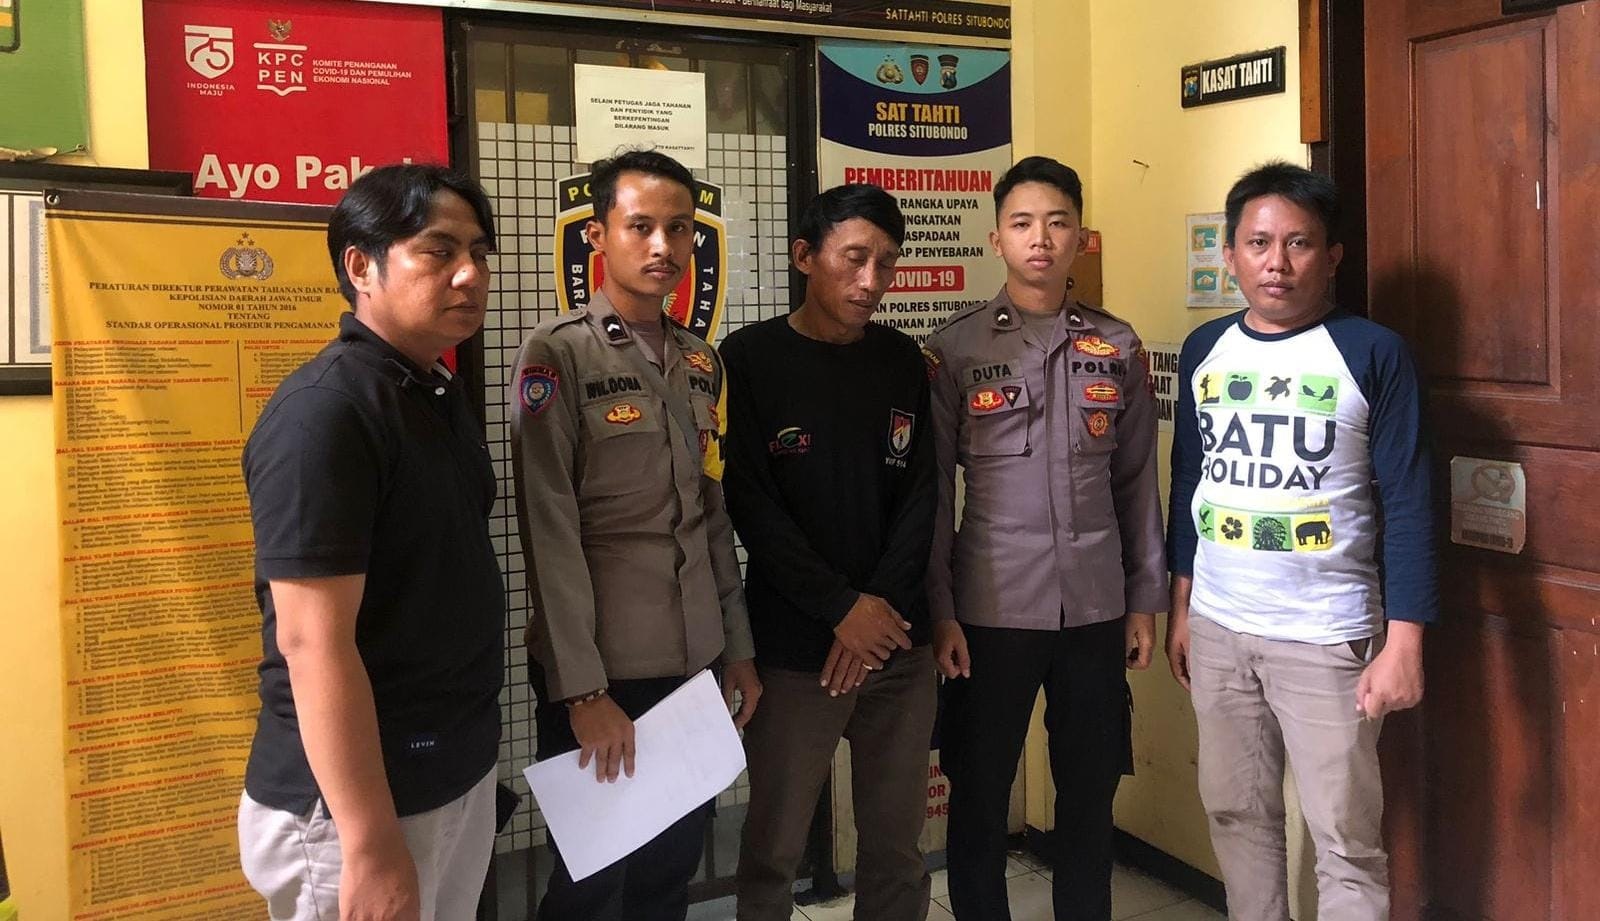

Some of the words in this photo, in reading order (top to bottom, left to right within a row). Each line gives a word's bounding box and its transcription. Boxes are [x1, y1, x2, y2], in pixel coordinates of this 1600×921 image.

[885, 8, 929, 23] SATTAHTI
[931, 11, 962, 25] POLRES
[966, 15, 1010, 29] SITUBONDO
[258, 52, 304, 67] KPC
[312, 59, 343, 68] KOMITE
[344, 61, 397, 70] PENANGANAN
[259, 69, 304, 84] PEN
[312, 68, 348, 76] COVID-19
[350, 68, 366, 77] DAN
[367, 70, 412, 78] PEMULIHAN
[1202, 64, 1238, 94] KASAT
[1238, 57, 1273, 88] TAHTI
[187, 82, 235, 90] INDONESIA
[313, 76, 350, 84] EKONOMI
[614, 115, 670, 123] BERKEPENTINGAN
[876, 102, 908, 122] SAT
[911, 103, 960, 124] TAHTI
[868, 123, 907, 138] POLRES
[909, 124, 968, 140] SITUBONDO
[195, 153, 280, 199] Ayo
[295, 155, 375, 190] Pak
[845, 167, 992, 192] PEMBERITAHUAN
[900, 198, 944, 209] RANGKA
[946, 199, 979, 210] UPAYA
[904, 214, 961, 226] INGKATKAN
[904, 231, 960, 242] ASPADAAN
[915, 247, 984, 258] PENYEBARAN
[89, 281, 150, 291] PERATURAN
[152, 283, 202, 292] DIREKTUR
[204, 285, 259, 293] PERAWATAN
[261, 286, 304, 294] TAHANAN
[169, 293, 228, 301] KEPOLISIAN
[229, 294, 266, 302] DAERAH
[294, 295, 322, 303] TIMUR
[694, 266, 715, 329] TAHA
[198, 303, 234, 311] NOMOR
[247, 303, 278, 311] TAHUN
[889, 301, 930, 312] POLRES
[228, 312, 270, 320] TENTANG
[106, 320, 151, 329] STANDAR
[154, 321, 222, 329] OPERASIONAL
[224, 321, 272, 329] PROSEDUR
[1152, 351, 1179, 374] TANG
[972, 363, 1012, 383] DUTA
[1199, 411, 1337, 463] BATU
[929, 784, 946, 799] OR
